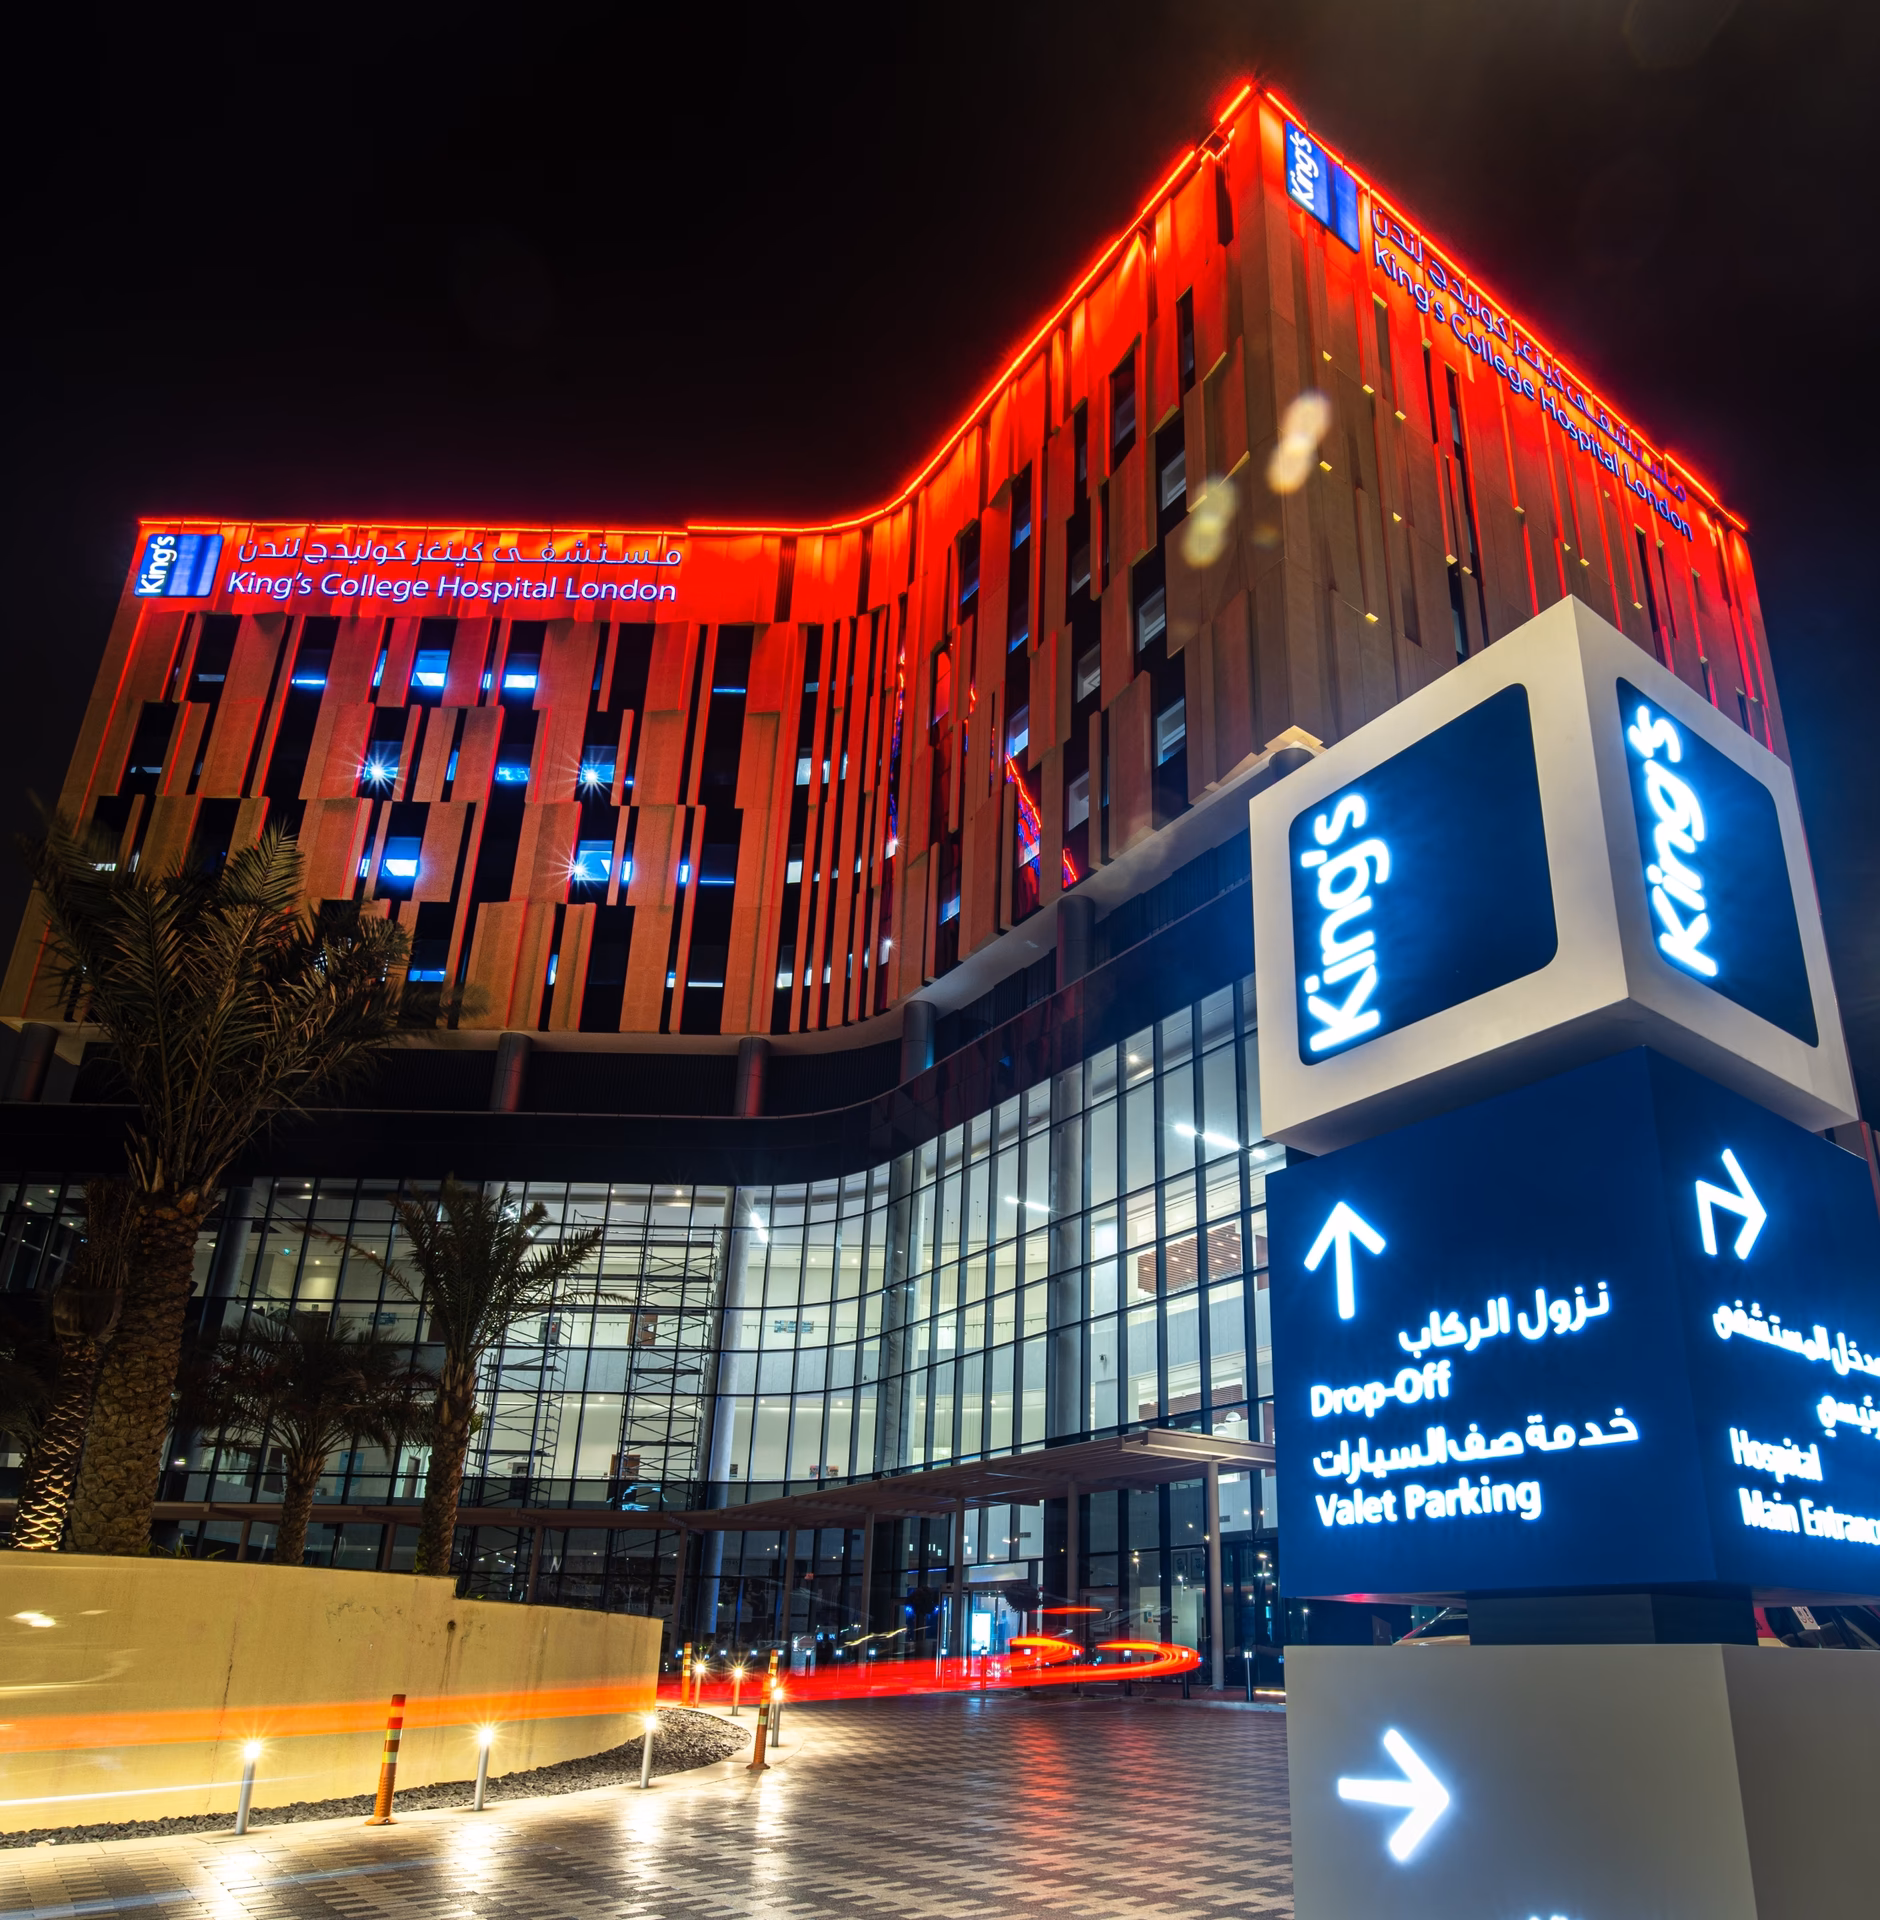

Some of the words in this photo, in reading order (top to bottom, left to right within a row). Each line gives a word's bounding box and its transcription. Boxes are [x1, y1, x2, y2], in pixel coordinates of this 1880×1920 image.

[1289, 131, 1320, 211] King's
[1372, 207, 1423, 263] لندن
[1428, 260, 1508, 341] كوليدج
[1374, 239, 1446, 323] King's
[1451, 313, 1535, 401] College
[1540, 387, 1621, 478] Hospital
[1623, 463, 1694, 543] London
[1513, 332, 1564, 392] كينغز
[138, 535, 178, 594] King's
[238, 538, 301, 563] لندن
[304, 540, 407, 565] كوليدج
[411, 540, 484, 568] كينغز
[492, 540, 682, 565] مستشفى
[228, 571, 313, 600] King's
[320, 573, 429, 603] College
[437, 575, 557, 604] Hospital
[564, 576, 677, 602] London
[1629, 705, 1718, 977] King's
[1301, 794, 1391, 1052] King's
[1398, 1297, 1512, 1359] الركاب
[1517, 1281, 1611, 1340] نزول
[1310, 1359, 1451, 1418] Drop-Off
[1313, 1425, 1449, 1485] السيارات
[1446, 1423, 1525, 1462] صف
[1525, 1407, 1640, 1451] خدمة
[1729, 1427, 1824, 1484] Hospital
[1315, 1488, 1398, 1527] Valet
[1404, 1475, 1542, 1521] Parking
[1738, 1487, 1801, 1534] Main
[1799, 1498, 1880, 1546] Entranc
